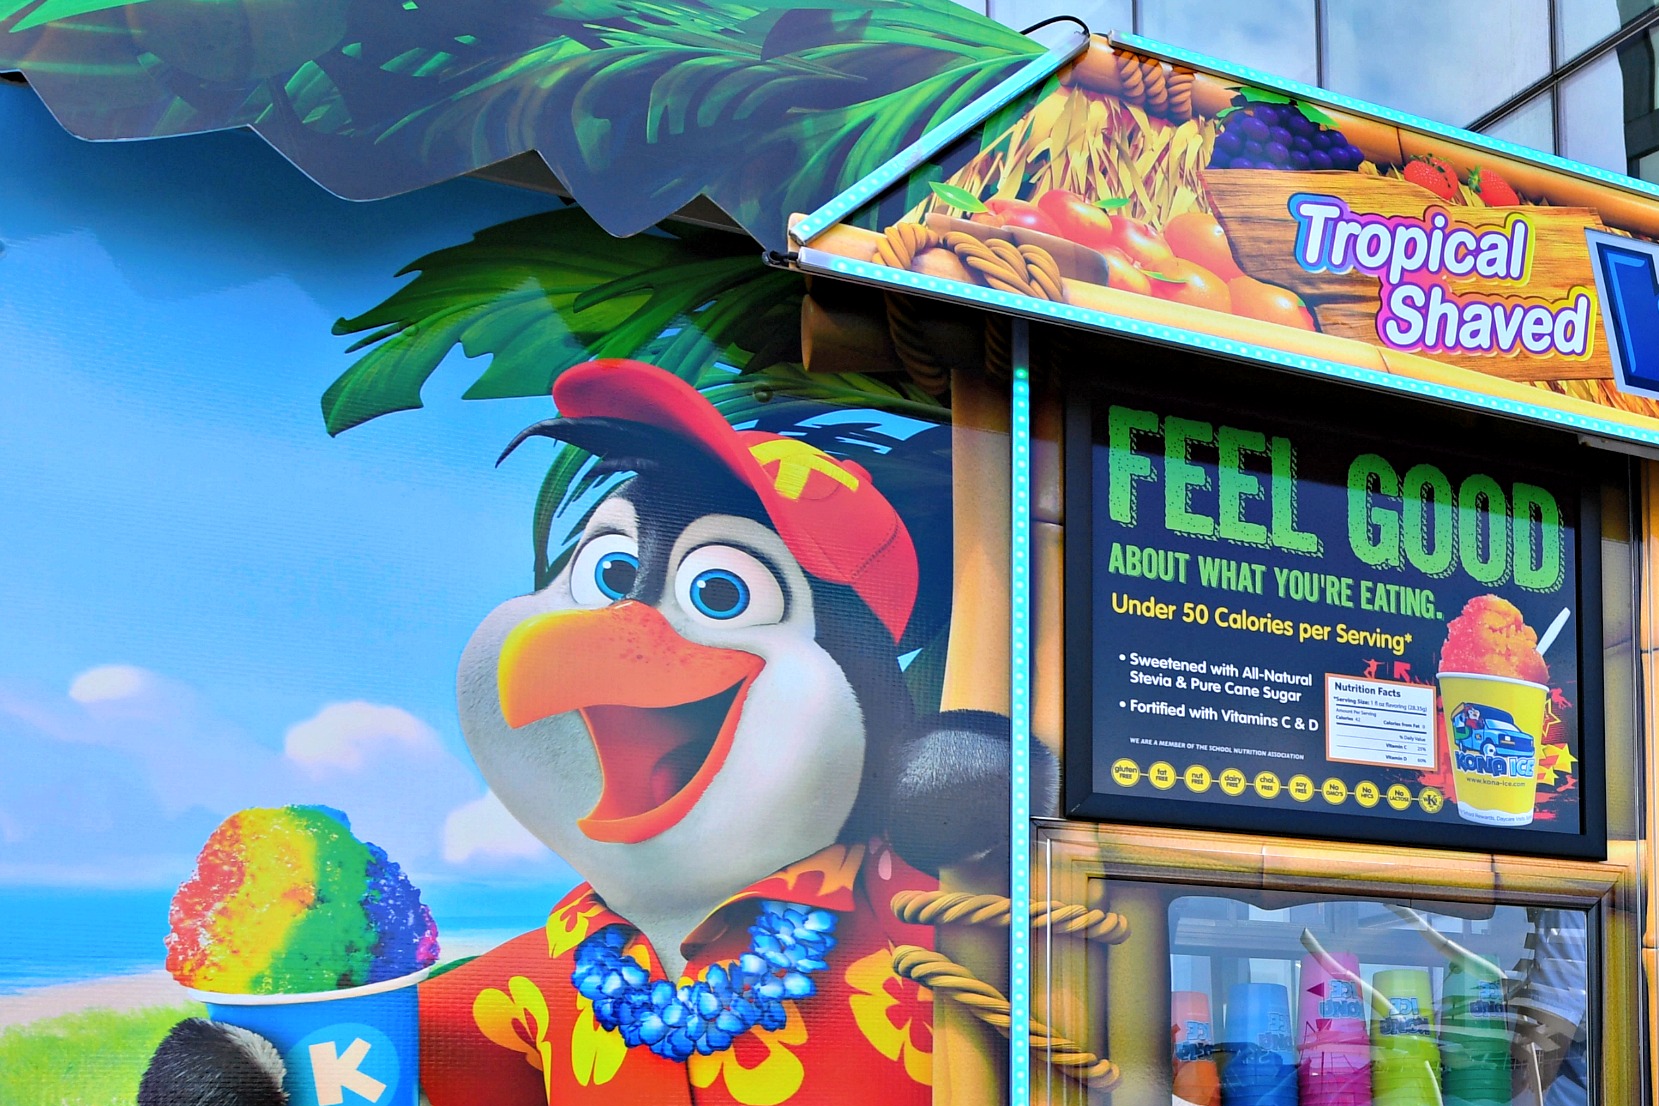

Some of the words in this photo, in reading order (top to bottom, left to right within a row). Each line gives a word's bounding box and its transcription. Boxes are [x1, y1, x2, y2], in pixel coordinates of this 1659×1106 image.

[1296, 199, 1529, 285] Tropical
[1383, 282, 1591, 356] Shaved
[1109, 405, 1321, 556] FEEL
[1347, 453, 1563, 592] GOOD
[1109, 543, 1190, 583] ABOUT
[1198, 555, 1265, 595] WHAT
[1274, 567, 1354, 607] YOU'RE
[1361, 580, 1444, 620] EATING.
[1112, 592, 1176, 619] Under
[1182, 603, 1209, 624] 50
[1215, 608, 1293, 635] Calories
[1299, 622, 1331, 643] per
[1130, 653, 1206, 673] Sweetened
[1210, 663, 1238, 677] with
[1242, 666, 1312, 686] All-Natural
[1130, 670, 1172, 687] Stevia
[1176, 676, 1187, 689] &
[1191, 679, 1221, 693] Pure
[1224, 681, 1259, 697] Cane
[1262, 686, 1301, 703] Sugar
[1334, 682, 1376, 695] Nutrition
[1378, 687, 1401, 698] Facts
[1130, 700, 1185, 717] Fortified
[1189, 707, 1218, 721] with
[1221, 710, 1278, 727] Vitamins
[1281, 716, 1291, 728] C
[1294, 717, 1305, 730] &
[1308, 719, 1319, 731] D
[1114, 765, 1137, 774] gluten
[1455, 751, 1507, 776] KONA
[1509, 758, 1534, 777] ICE
[308, 1037, 387, 1106] K
